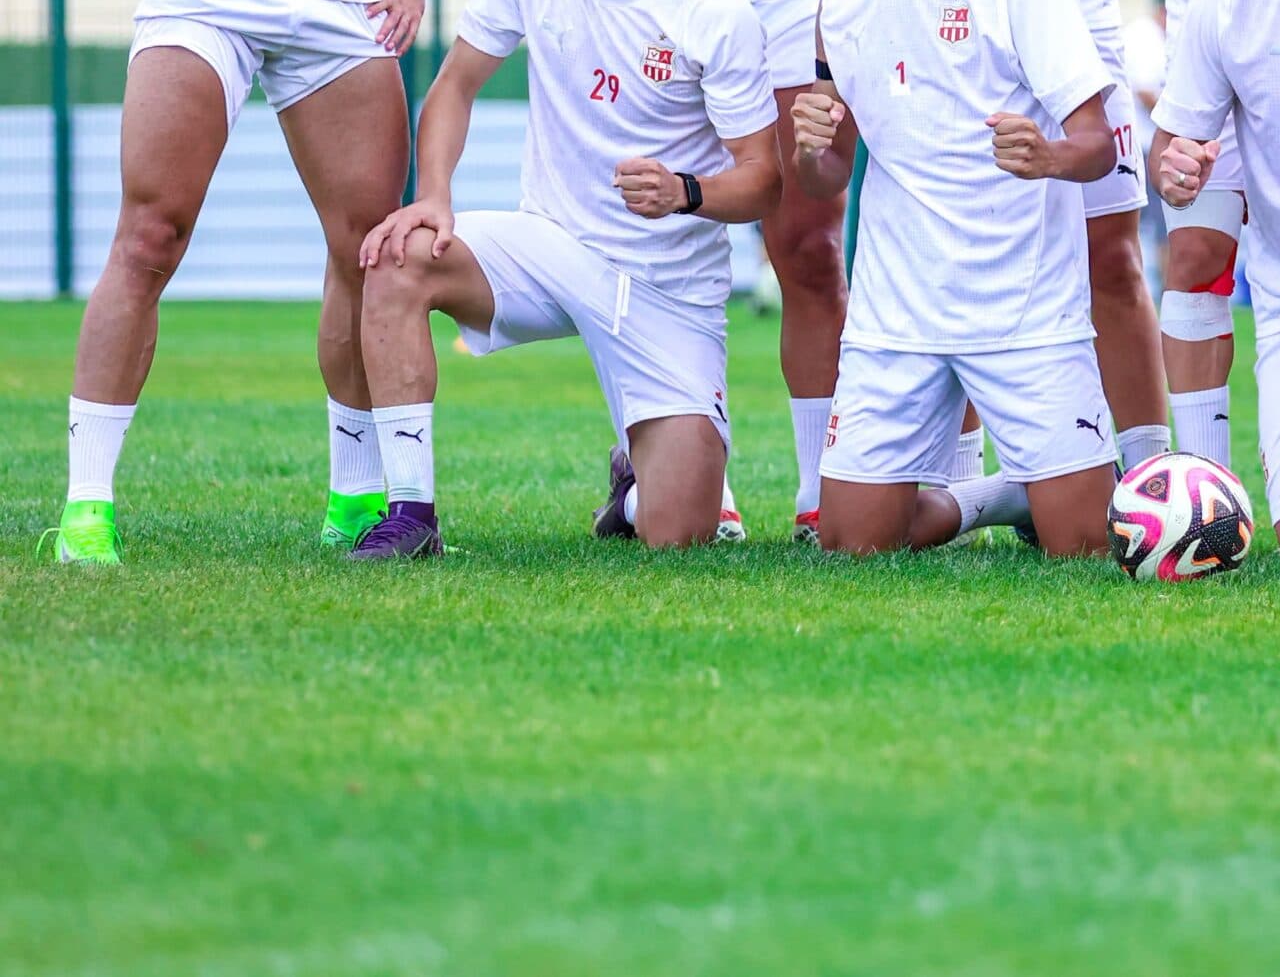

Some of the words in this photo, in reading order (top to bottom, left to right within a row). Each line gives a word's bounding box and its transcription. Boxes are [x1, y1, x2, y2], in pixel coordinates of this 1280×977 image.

[589, 67, 620, 103] 29
[895, 61, 906, 84] 1
[1114, 124, 1132, 157] 17
